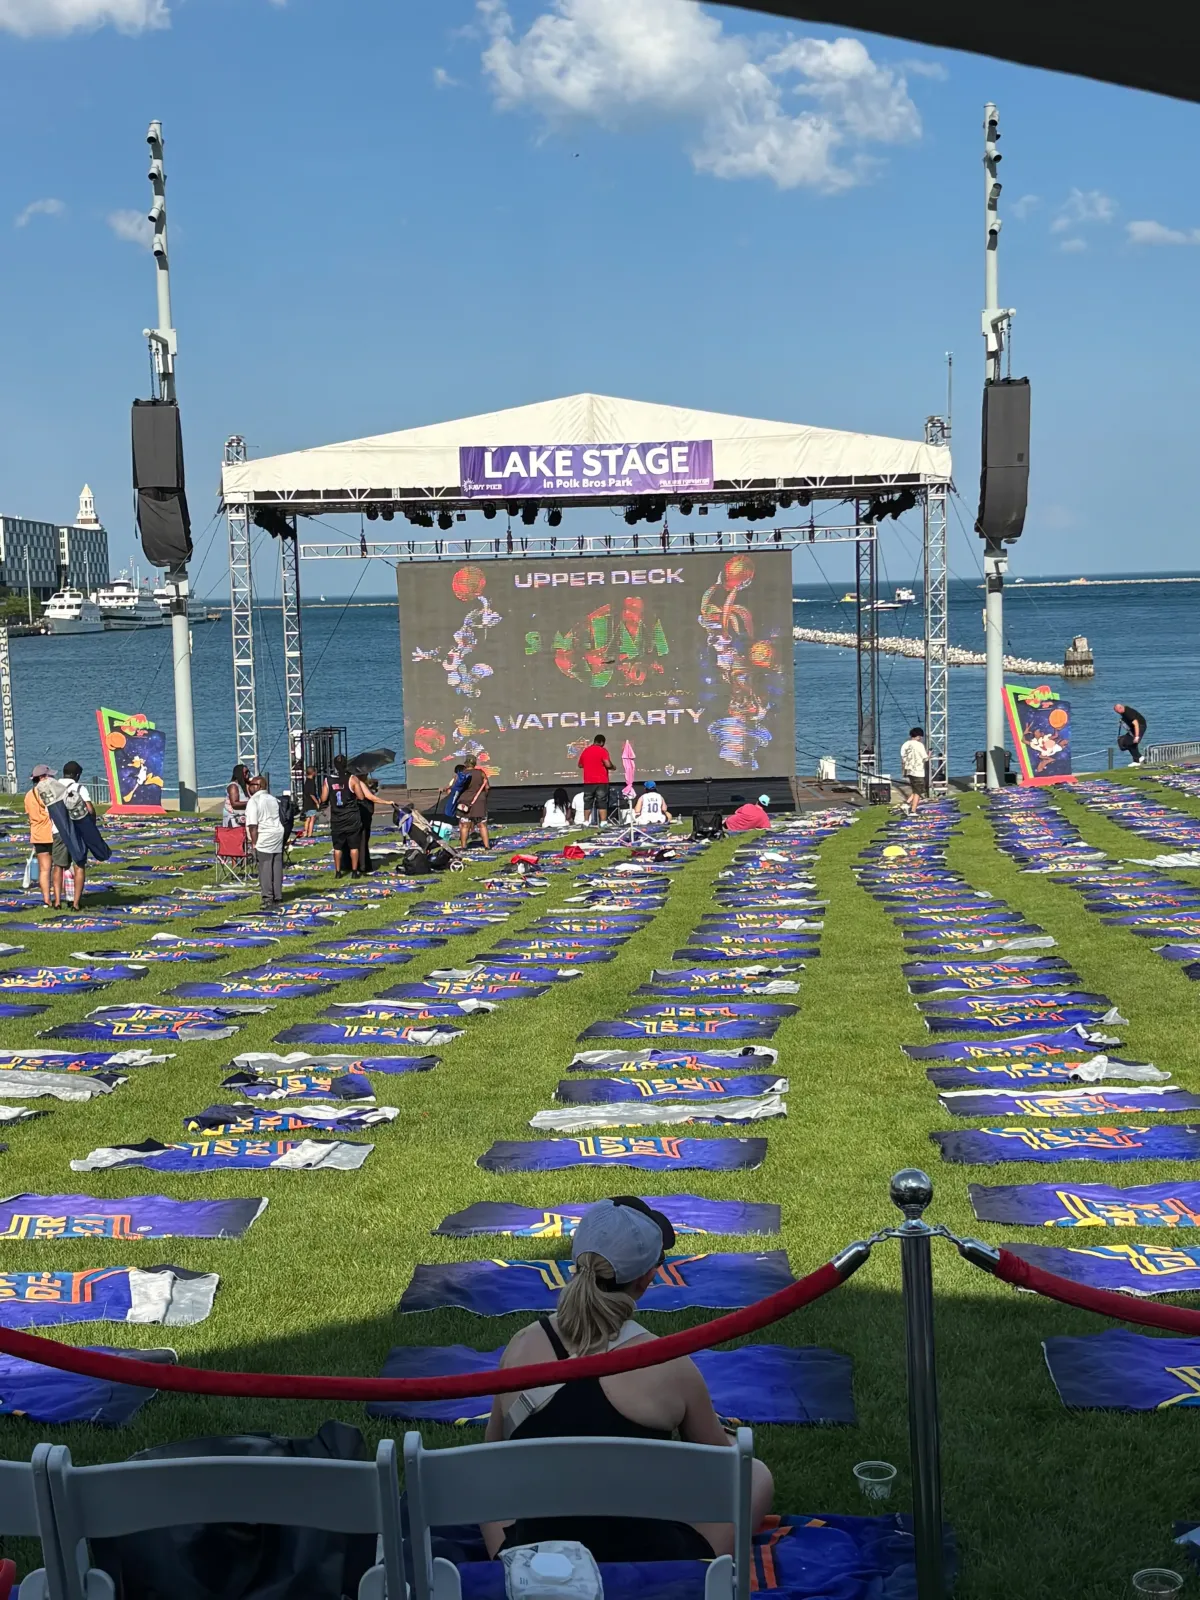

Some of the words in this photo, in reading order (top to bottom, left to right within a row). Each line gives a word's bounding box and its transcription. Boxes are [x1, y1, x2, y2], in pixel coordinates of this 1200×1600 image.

[484, 449, 573, 478] LAKE
[582, 446, 690, 477] STAGE
[556, 478, 581, 489] Polk
[582, 478, 607, 488] Bros
[608, 477, 633, 487] Park
[514, 571, 605, 589] UPPER
[611, 567, 685, 585] DECK
[0, 629, 9, 678] PARK
[3, 684, 13, 730] BROS
[493, 711, 600, 732] WATCH
[607, 708, 706, 727] PARTY
[5, 736, 16, 784] POLK
[336, 791, 343, 806] 1
[647, 802, 659, 813] 10
